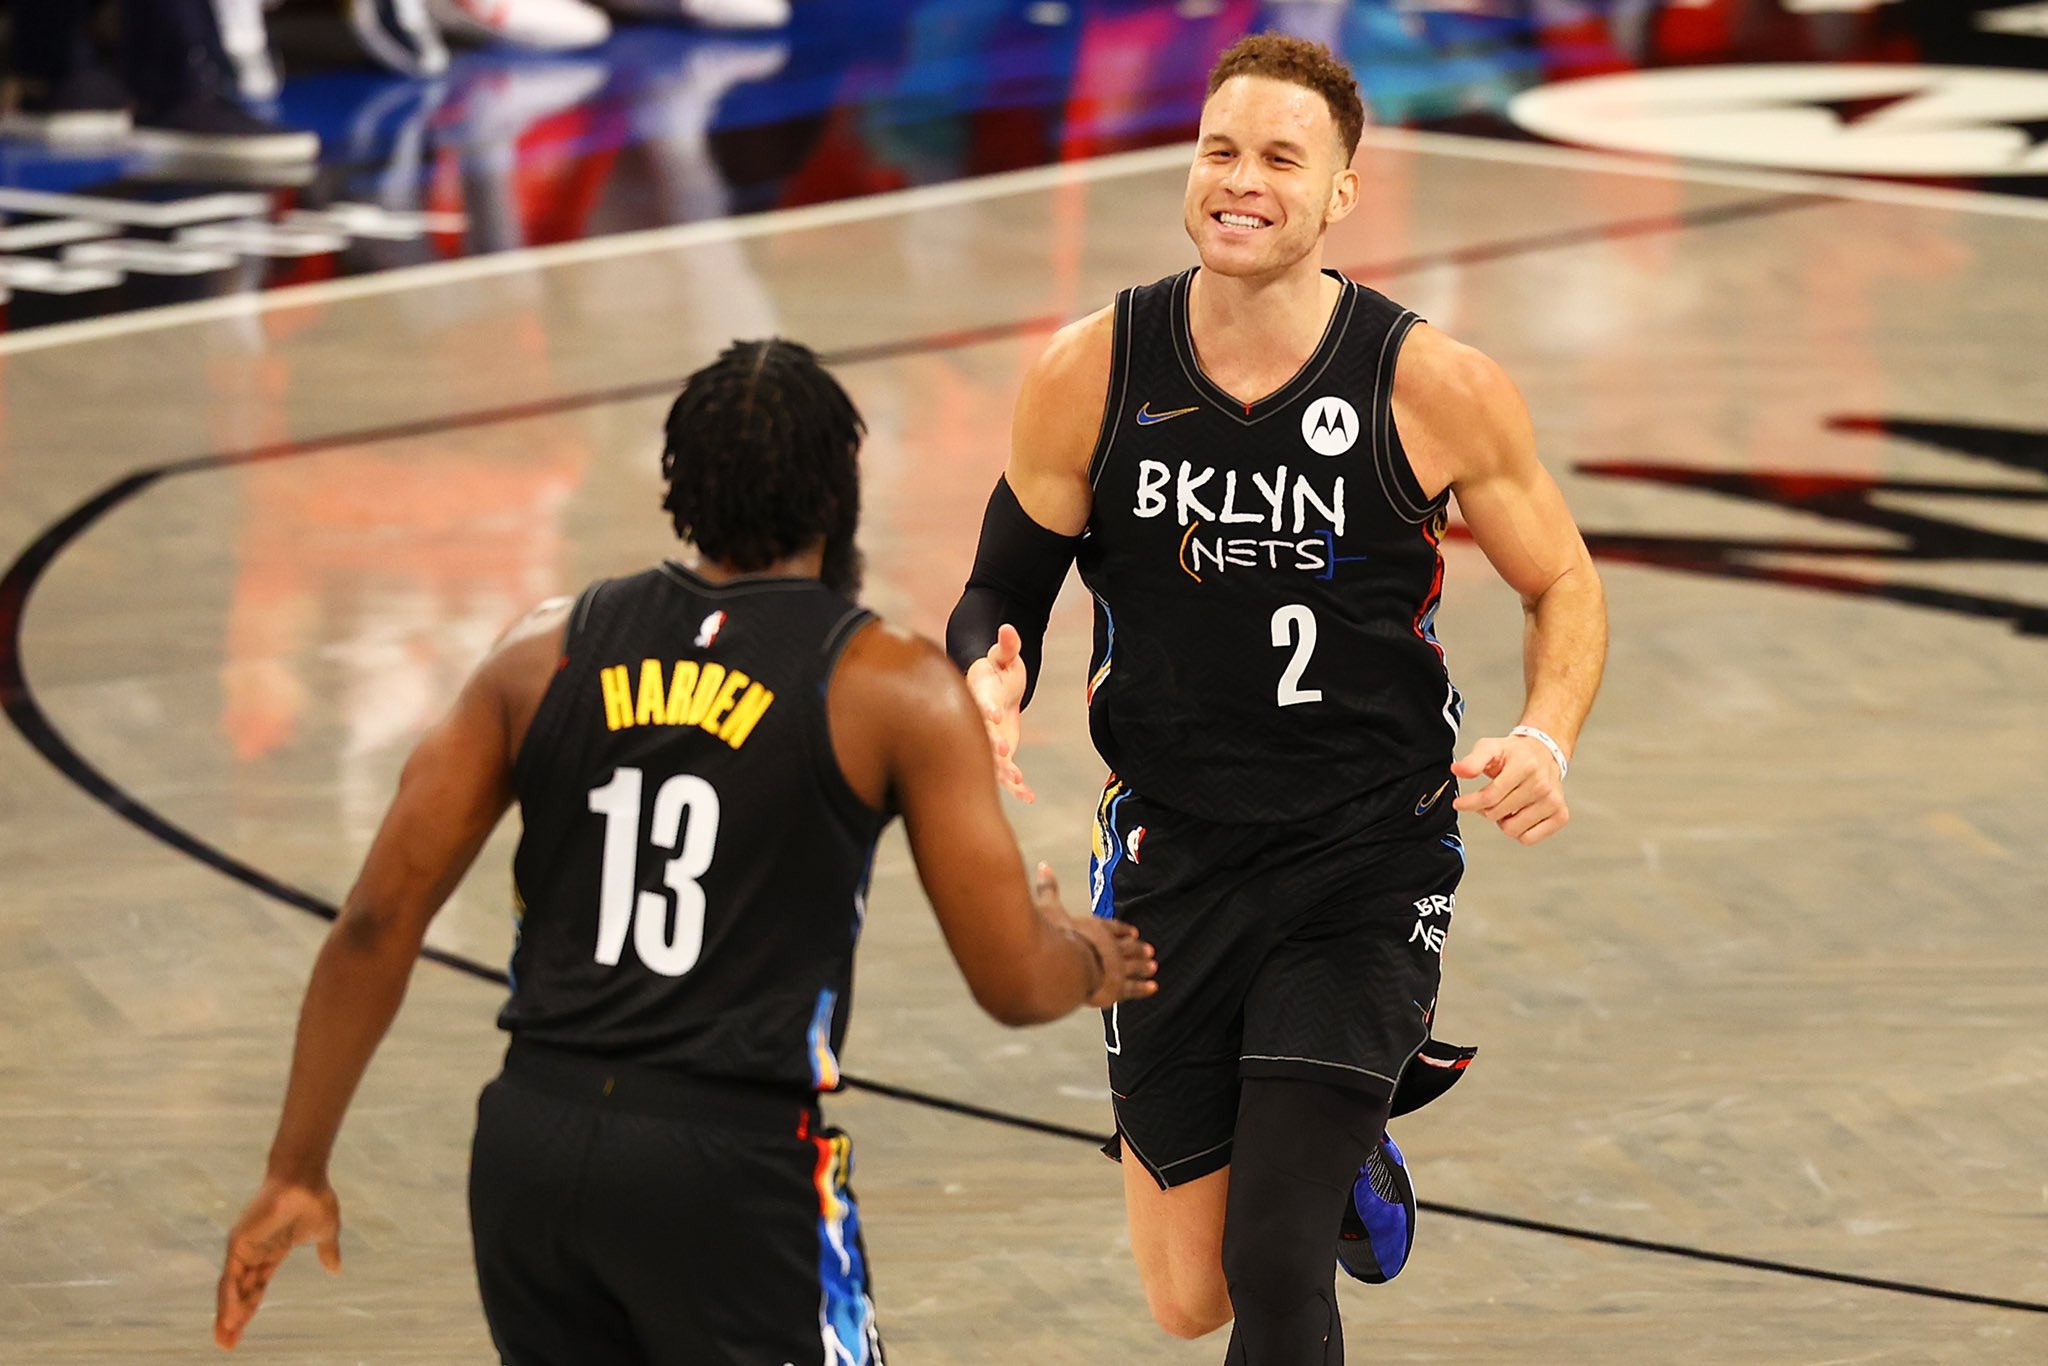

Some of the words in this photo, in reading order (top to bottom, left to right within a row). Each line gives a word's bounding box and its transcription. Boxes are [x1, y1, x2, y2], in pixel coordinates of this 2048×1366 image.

[1133, 459, 1345, 537] BKLYN
[600, 658, 775, 750] HARDEN
[1271, 604, 1322, 707] 2
[587, 766, 720, 977] 13
